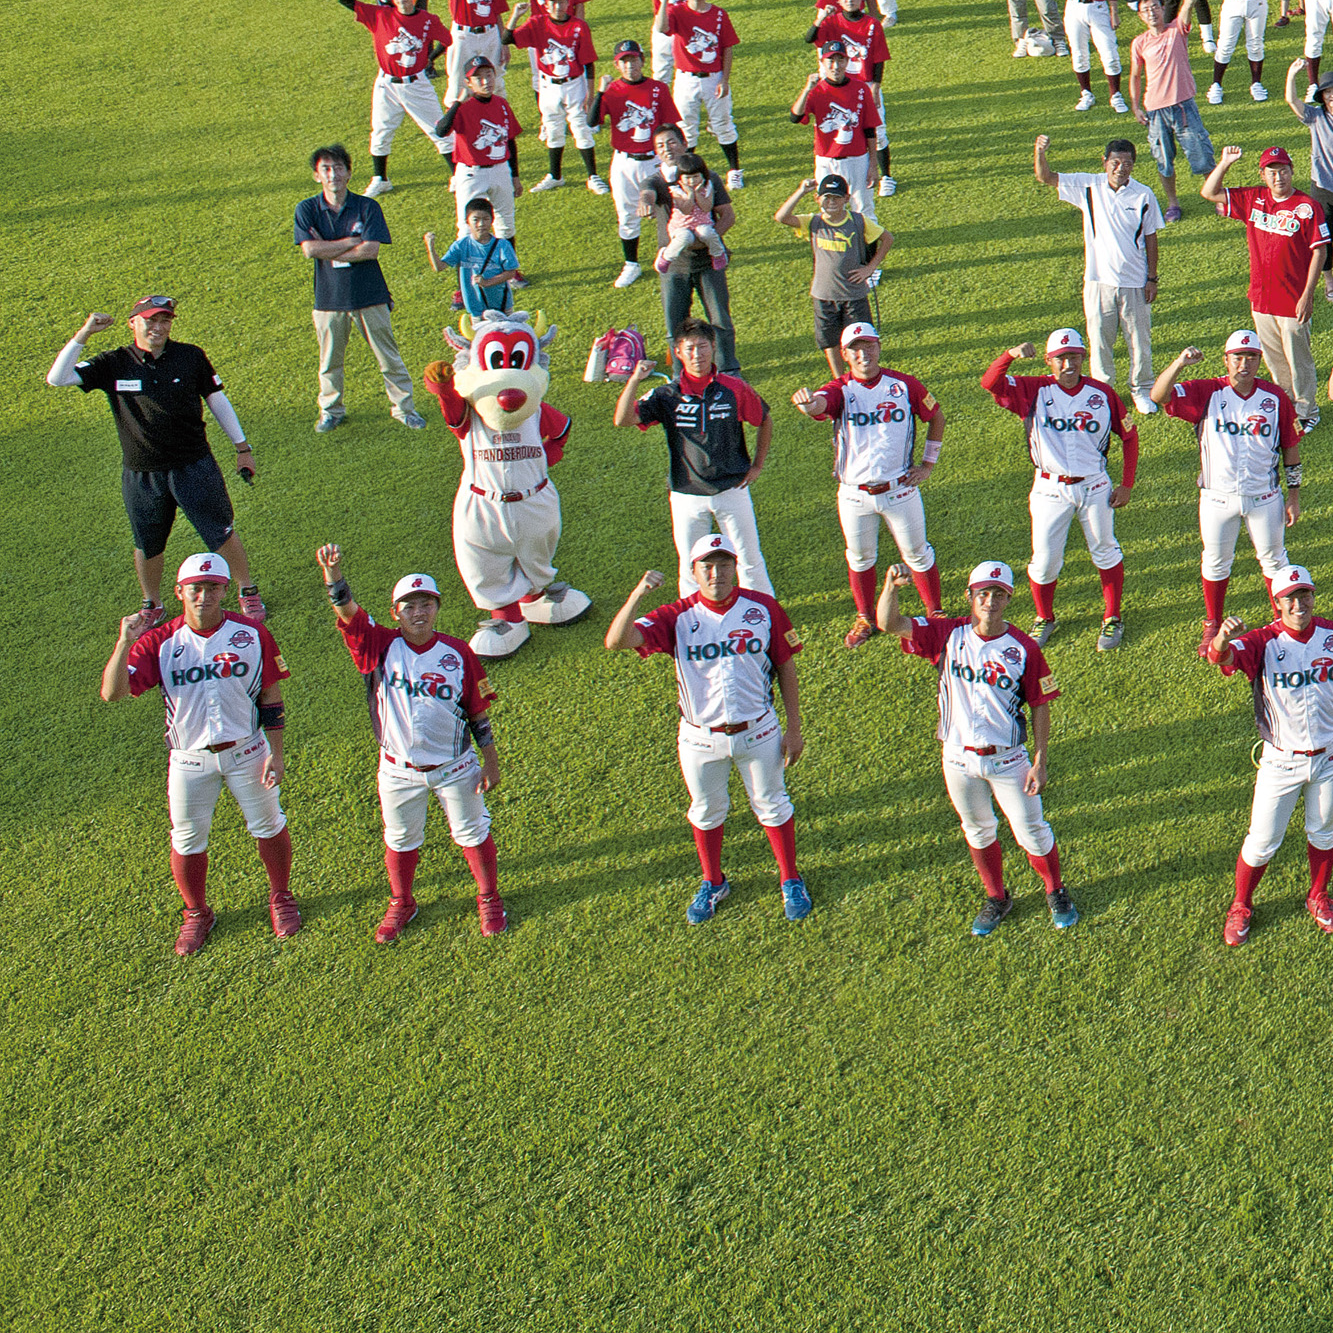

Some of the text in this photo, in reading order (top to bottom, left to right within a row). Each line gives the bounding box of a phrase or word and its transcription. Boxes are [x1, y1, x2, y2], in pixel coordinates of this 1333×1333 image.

[847, 402, 905, 426] HOKTO
[1043, 412, 1099, 434] HOKTO
[1216, 415, 1271, 437] HOKTO
[686, 629, 762, 661] HOKTO
[172, 652, 249, 687] HOKTO
[951, 660, 1012, 691] HOKTO
[389, 671, 453, 700] HOKTO
